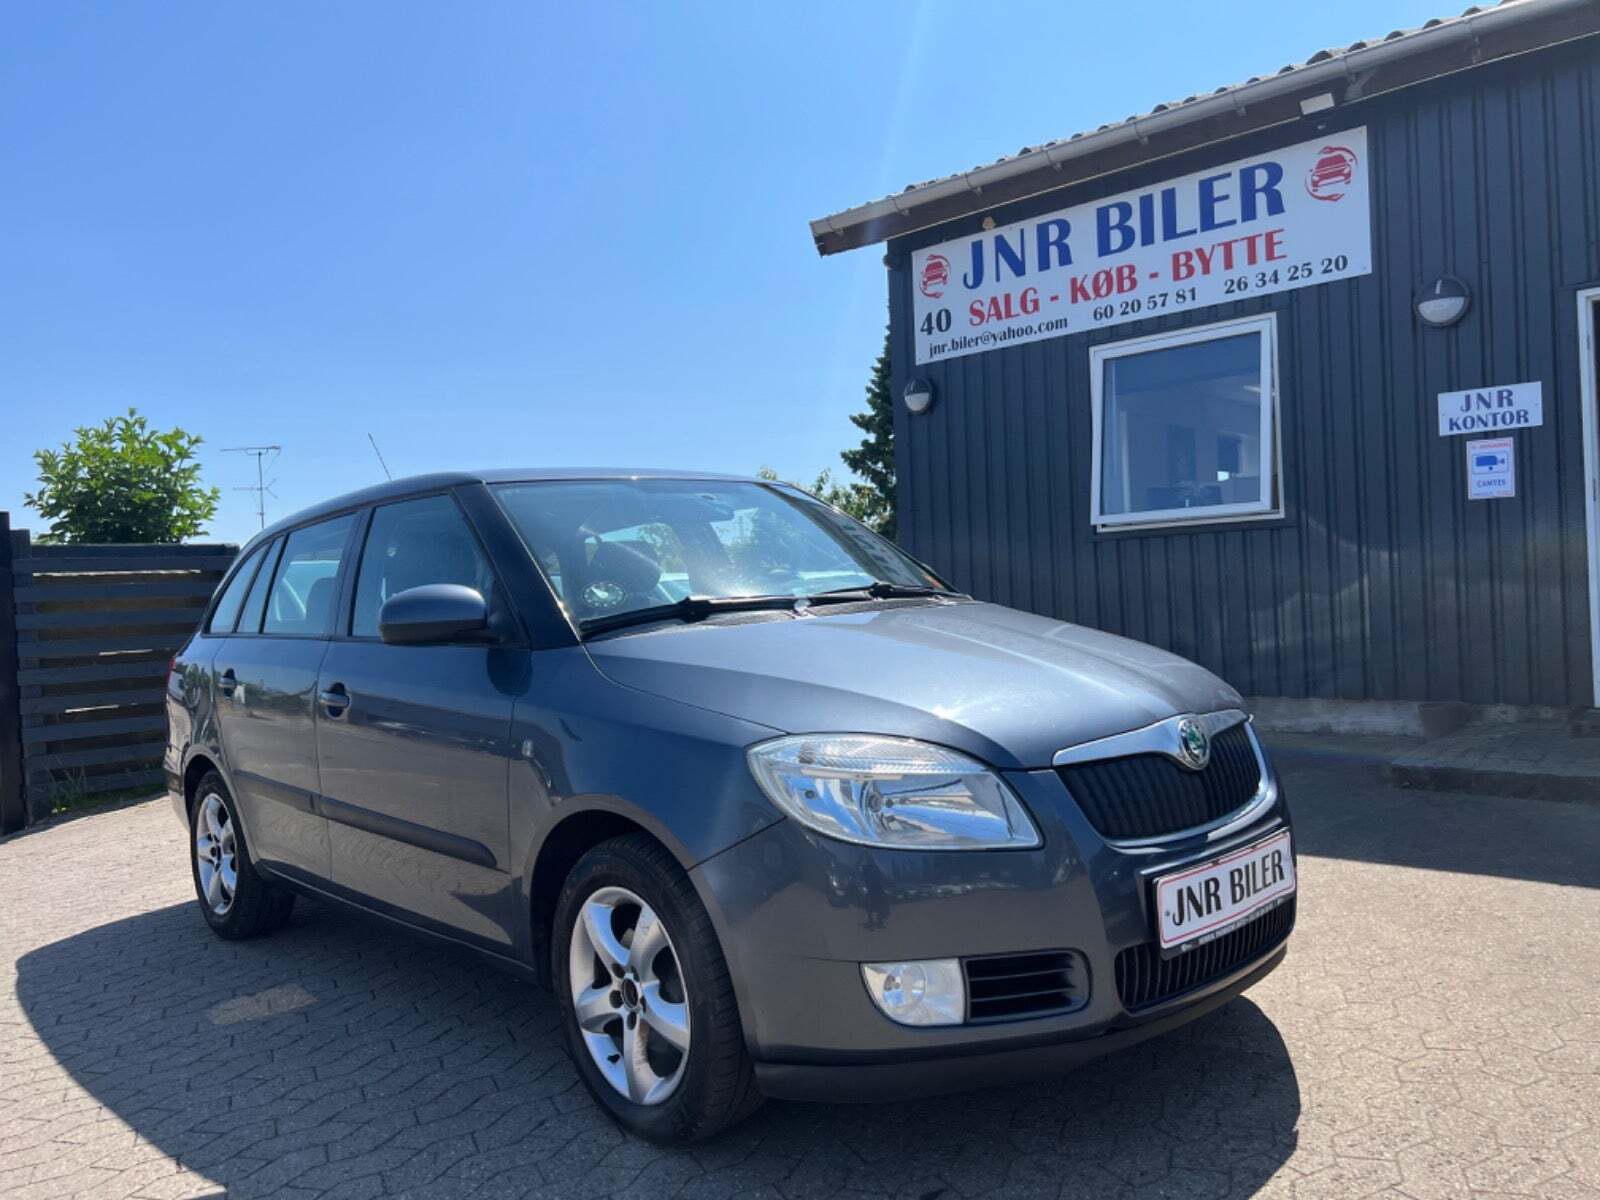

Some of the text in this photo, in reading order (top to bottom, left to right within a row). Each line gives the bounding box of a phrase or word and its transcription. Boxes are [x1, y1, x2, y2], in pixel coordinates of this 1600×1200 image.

[963, 161, 1286, 290] JNR BILER
[969, 287, 1040, 326] SALG
[1070, 264, 1138, 304] KØB
[1172, 228, 1287, 282] BYTTE
[1224, 254, 1349, 295] 26 34 25 20
[920, 308, 952, 336] 40
[1093, 286, 1197, 321] 60 20 57 81
[929, 316, 1068, 359] jnr.biler@yahoo.com
[1448, 408, 1529, 432] KONTOR
[1460, 388, 1513, 412] JNR
[1172, 876, 1222, 927] JNR
[1229, 849, 1285, 905] BILER
